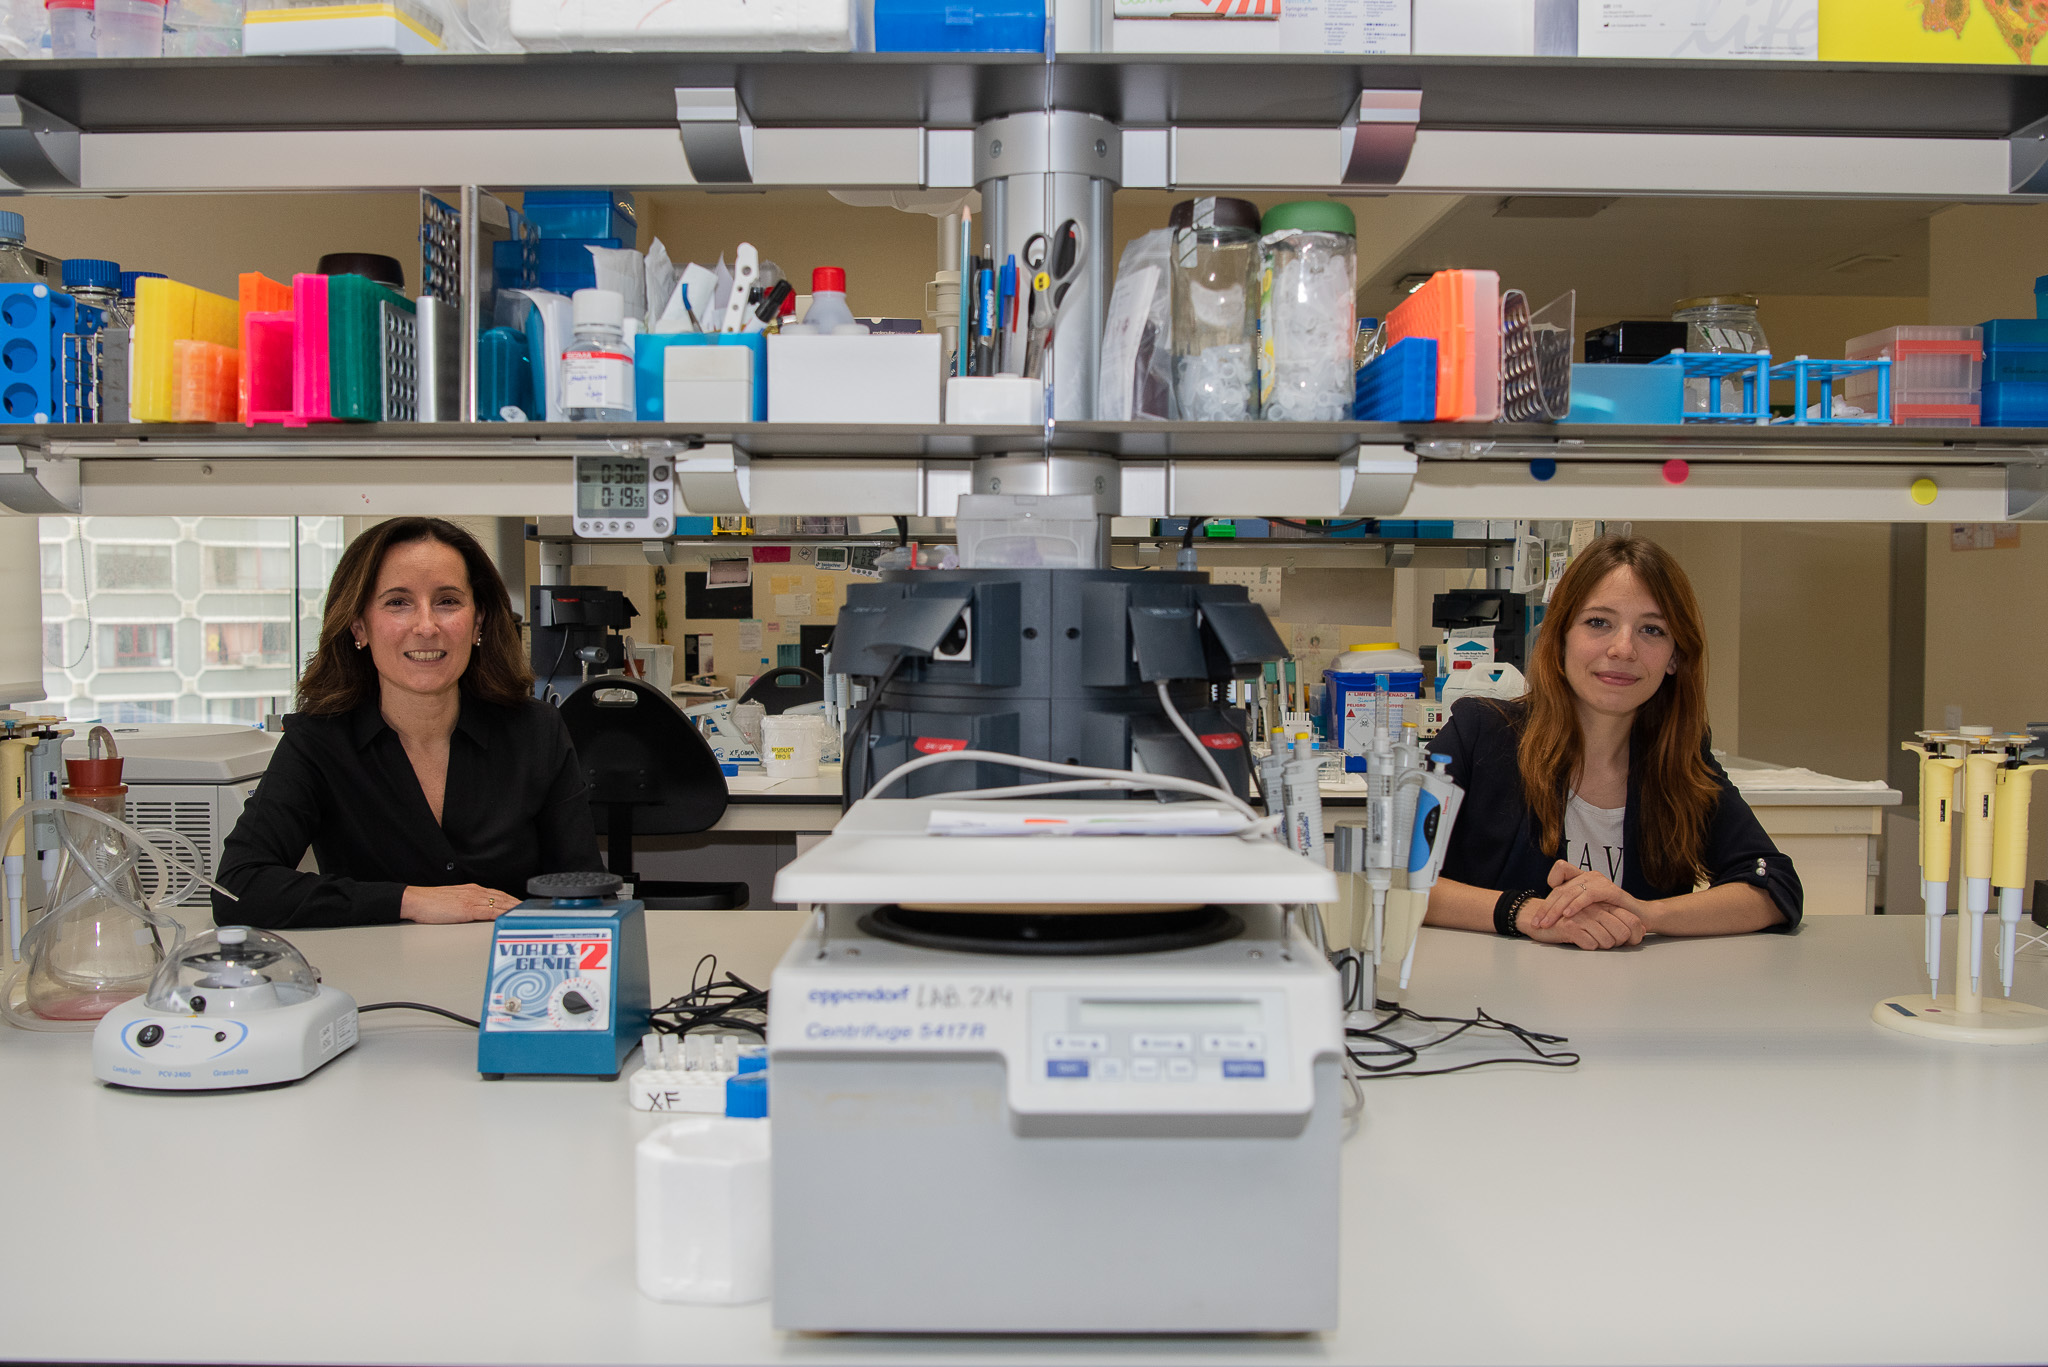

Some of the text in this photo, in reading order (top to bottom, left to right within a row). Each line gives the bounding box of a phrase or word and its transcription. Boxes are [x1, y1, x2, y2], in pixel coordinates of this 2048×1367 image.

[516, 957, 576, 970] GENIE
[808, 984, 909, 1006] eppendorf
[805, 1022, 912, 1043] Centrifuge
